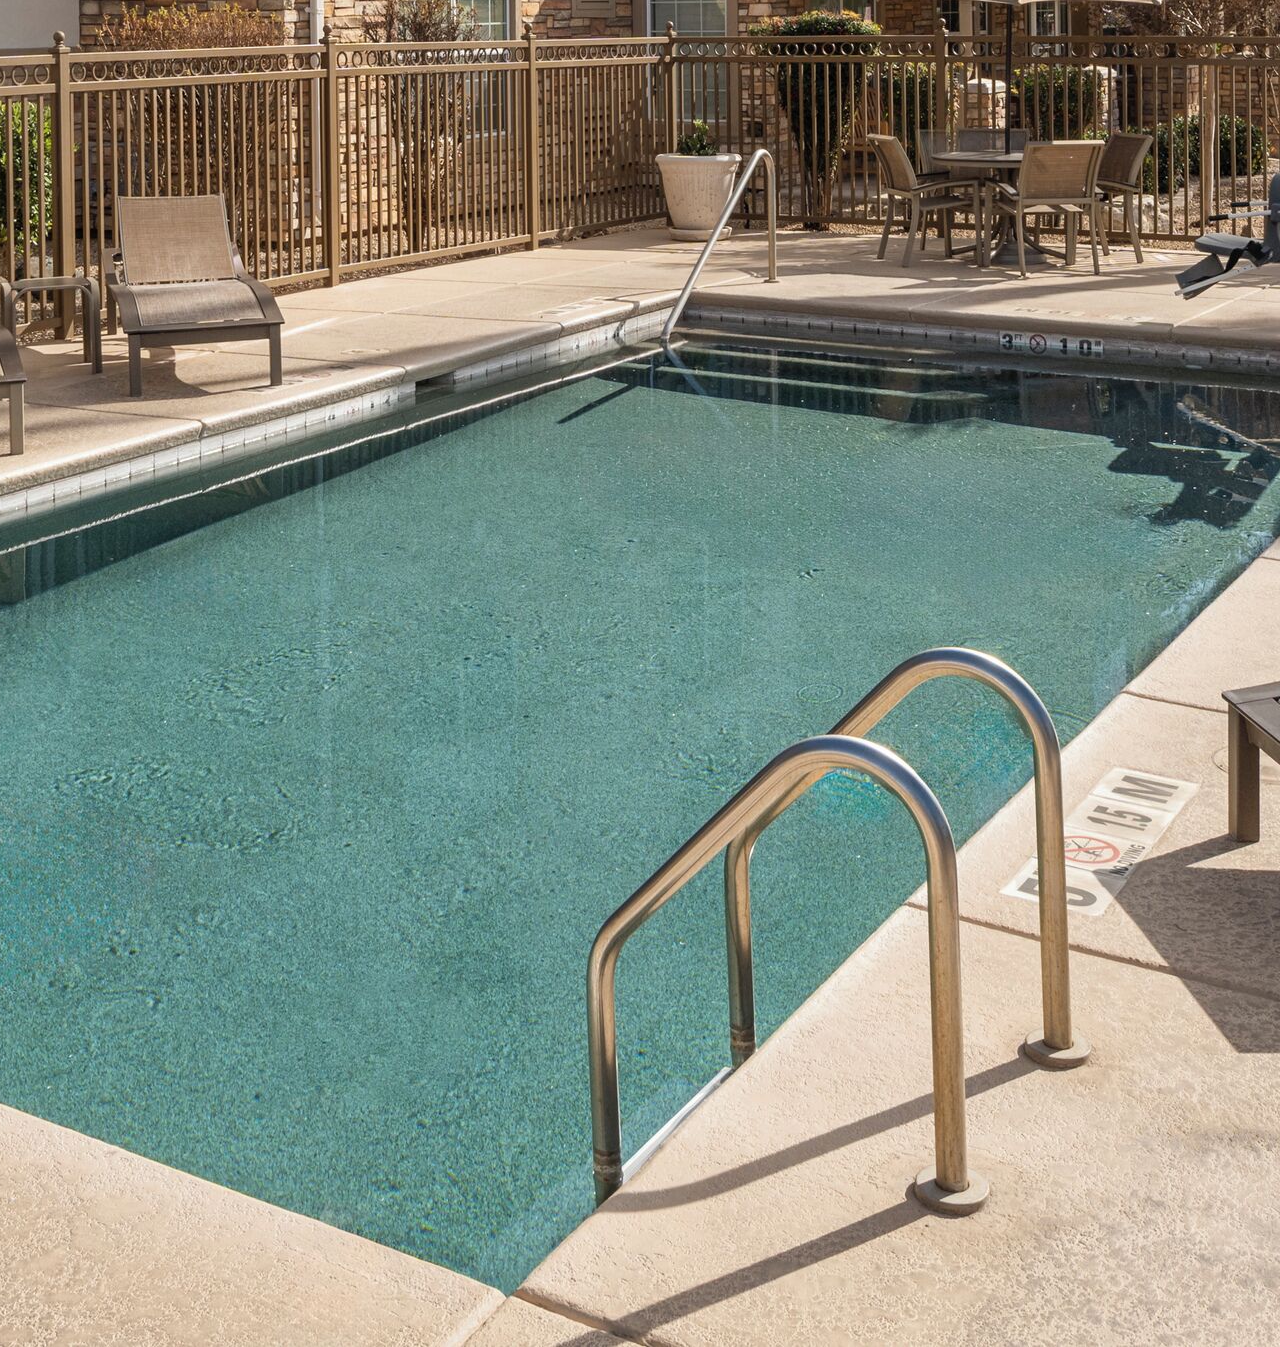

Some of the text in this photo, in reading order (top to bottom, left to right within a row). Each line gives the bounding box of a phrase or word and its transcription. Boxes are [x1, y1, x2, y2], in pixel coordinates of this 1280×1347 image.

[1111, 775, 1179, 804] M
[1086, 805, 1153, 831] 1.5
[1117, 843, 1146, 867] DIVING
